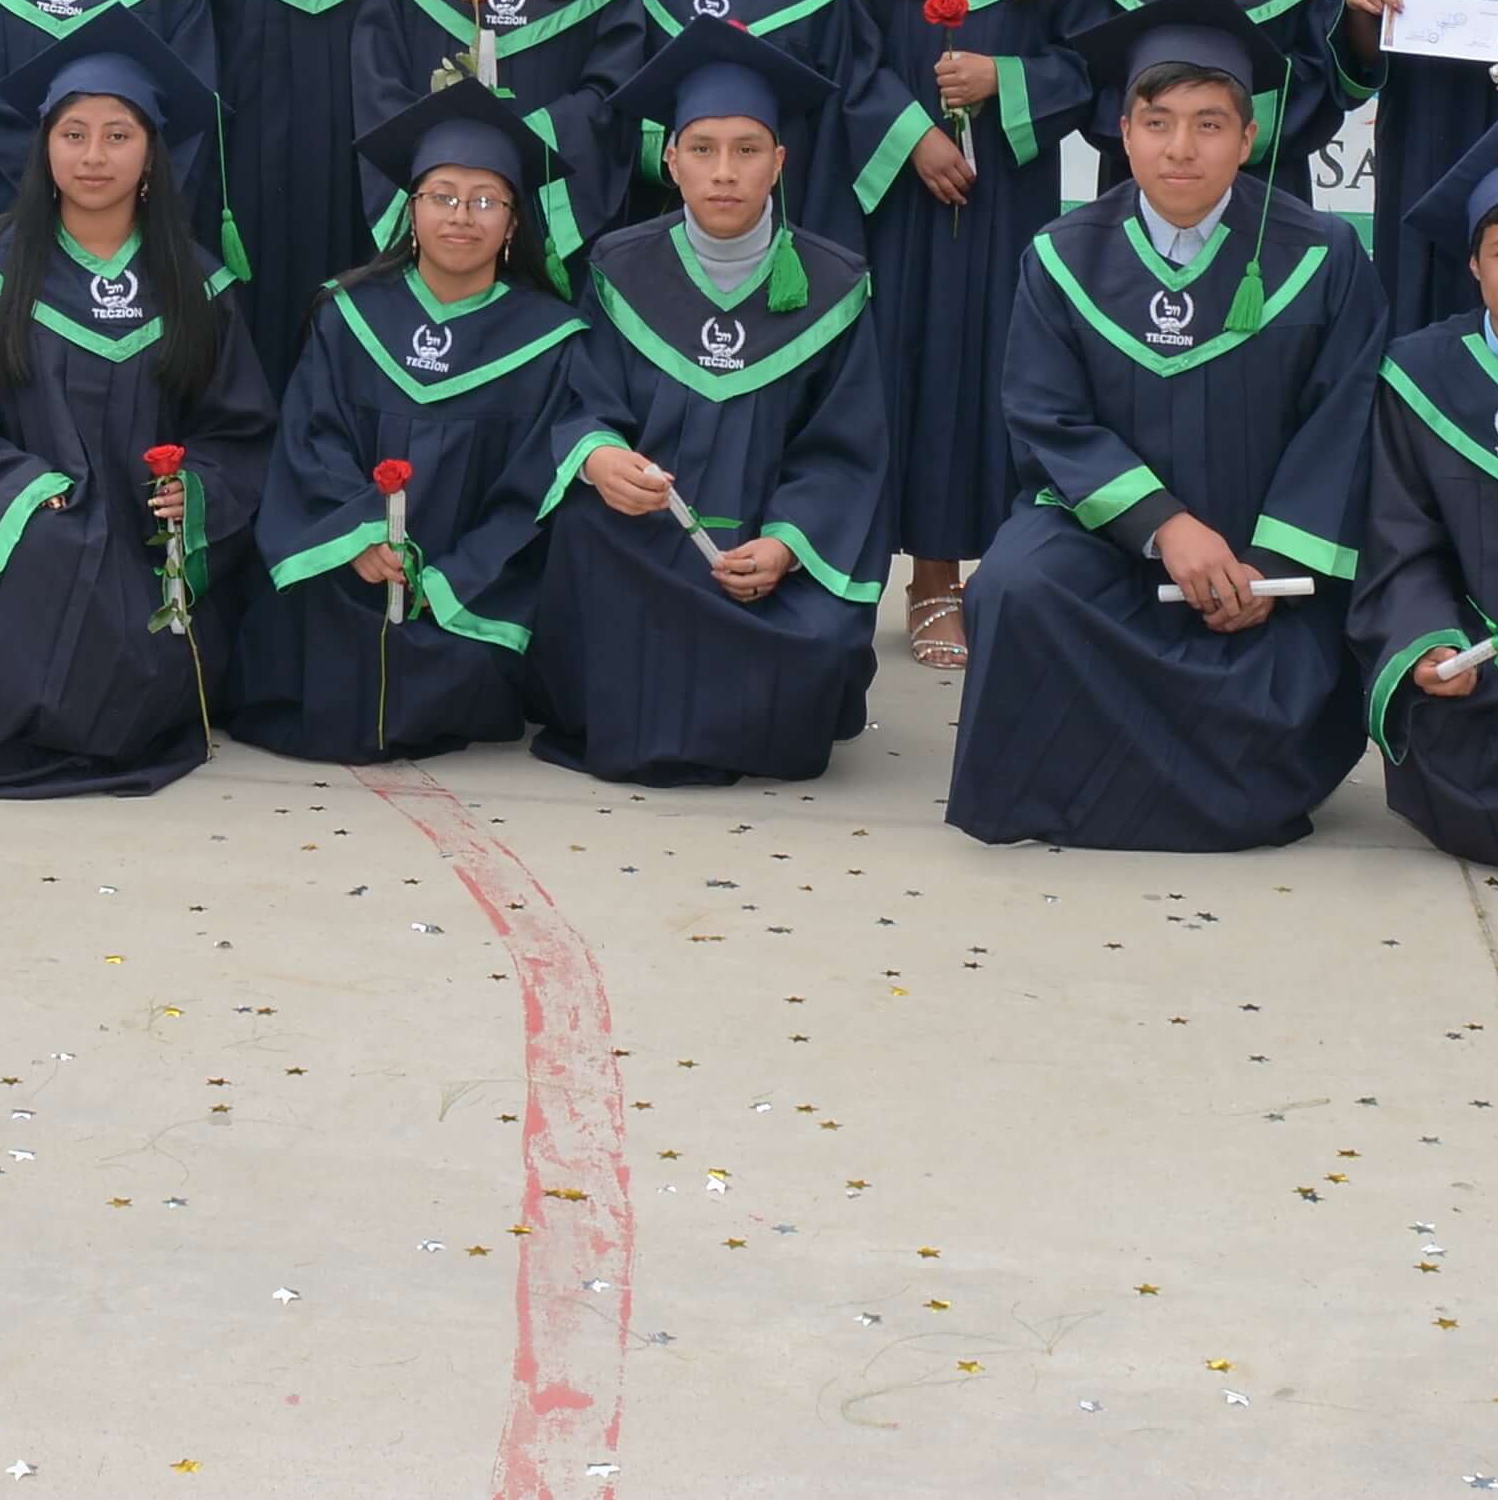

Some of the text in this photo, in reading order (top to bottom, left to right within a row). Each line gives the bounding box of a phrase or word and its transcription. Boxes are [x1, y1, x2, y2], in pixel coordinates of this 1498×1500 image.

[485, 14, 527, 25] TECZION
[91, 307, 143, 319] TECZION
[1145, 332, 1194, 346] TECZION
[405, 355, 450, 373] TECZION
[698, 355, 745, 369] TECZION
